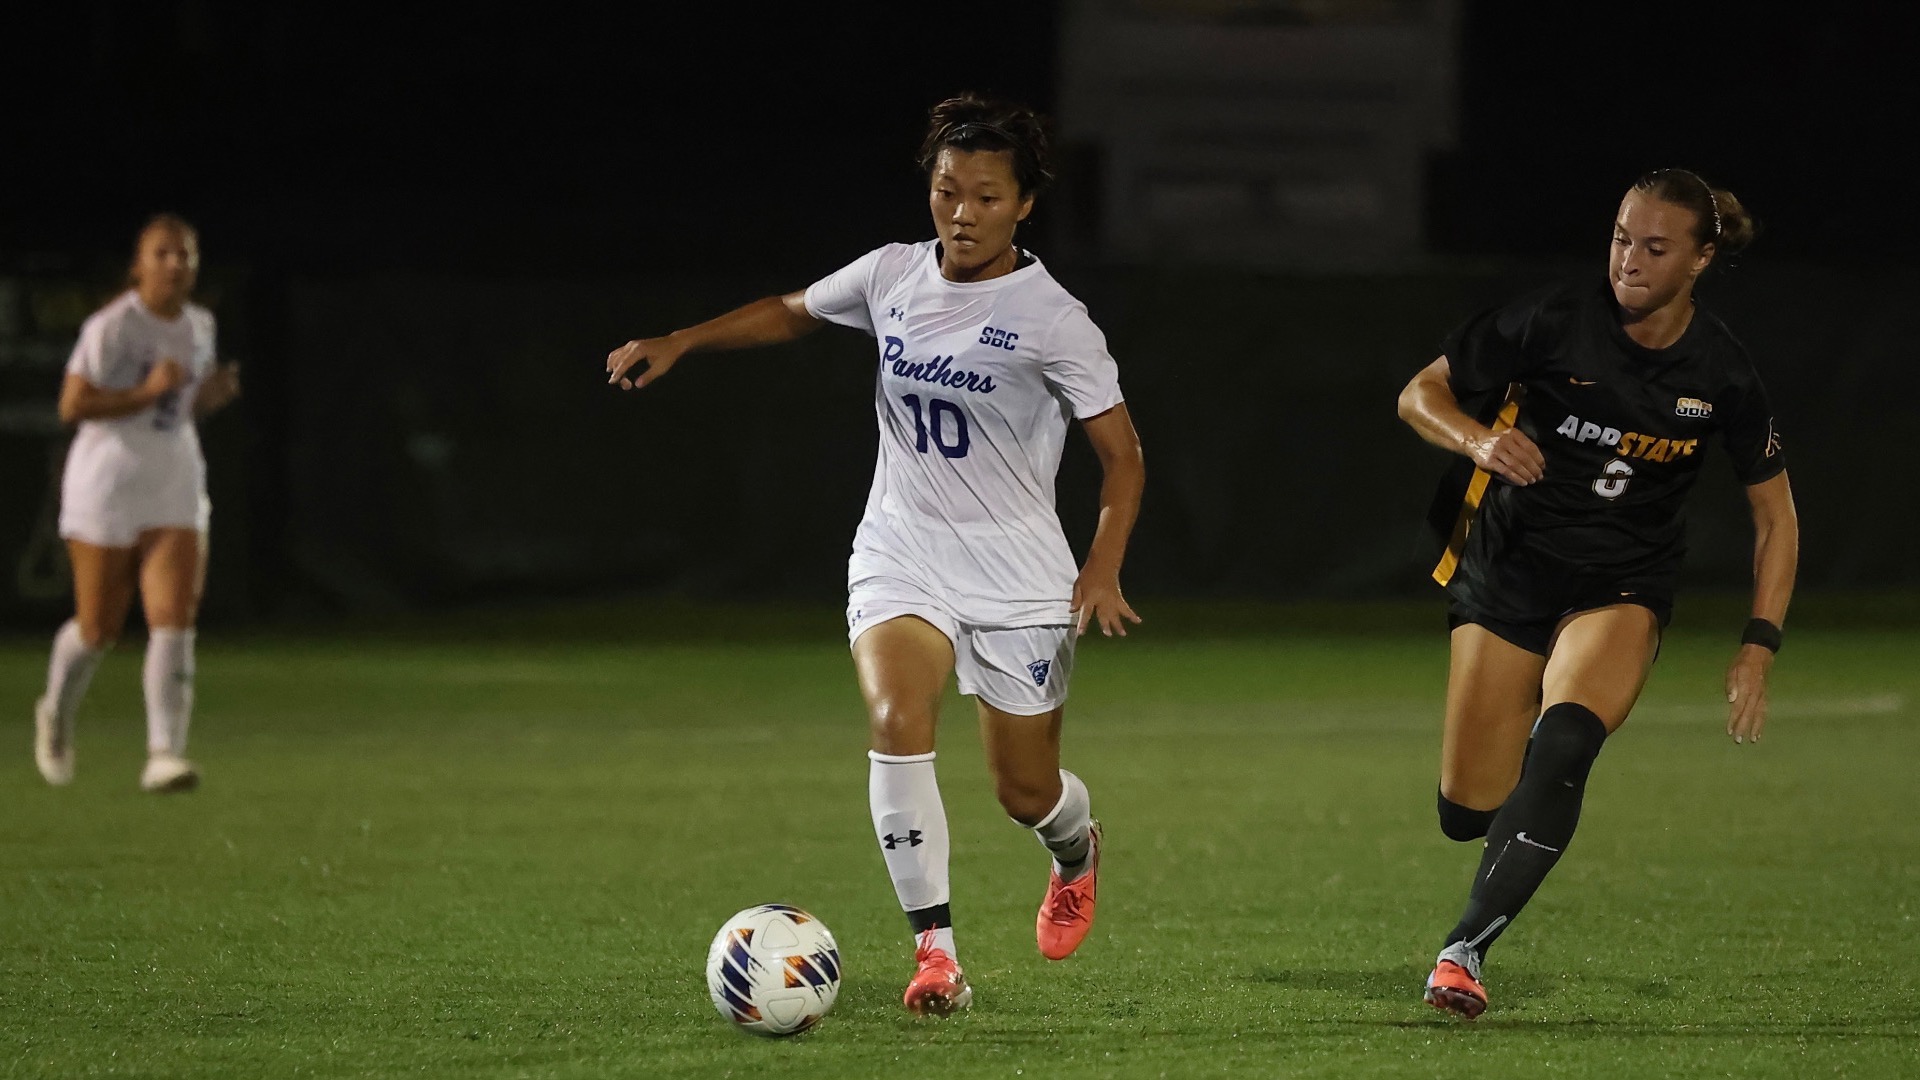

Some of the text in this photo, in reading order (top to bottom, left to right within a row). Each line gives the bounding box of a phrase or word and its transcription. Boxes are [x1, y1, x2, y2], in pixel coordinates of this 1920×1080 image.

[978, 326, 1019, 351] SBC
[882, 335, 996, 394] Panthers
[901, 393, 970, 459] 10
[1675, 397, 1713, 418] SBC
